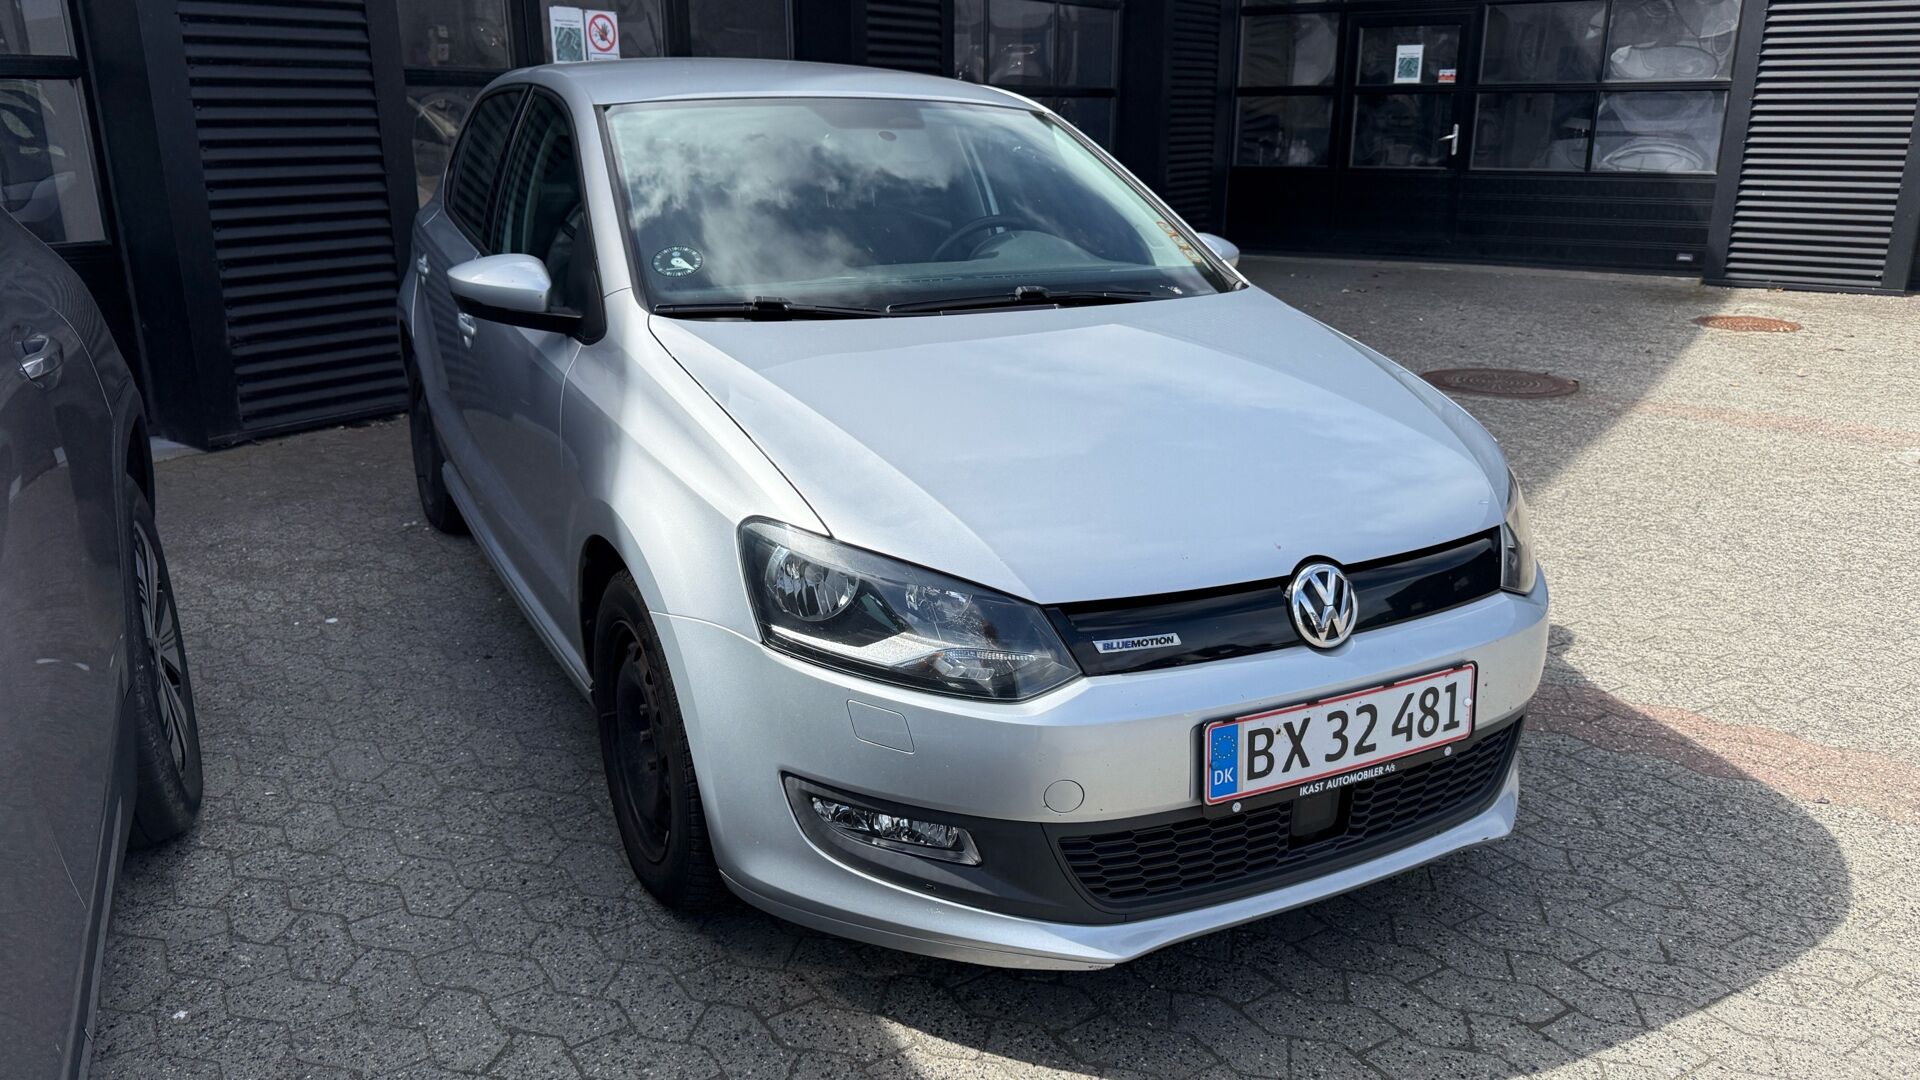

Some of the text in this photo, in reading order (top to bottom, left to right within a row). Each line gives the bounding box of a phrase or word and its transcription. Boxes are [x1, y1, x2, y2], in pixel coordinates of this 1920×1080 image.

[1102, 635, 1174, 650] BLUEMOTION
[1246, 681, 1460, 781] BX 32 481
[1214, 766, 1234, 785] DK
[1299, 781, 1325, 797] IKAST
[1325, 766, 1384, 790] AUTOMOBILER
